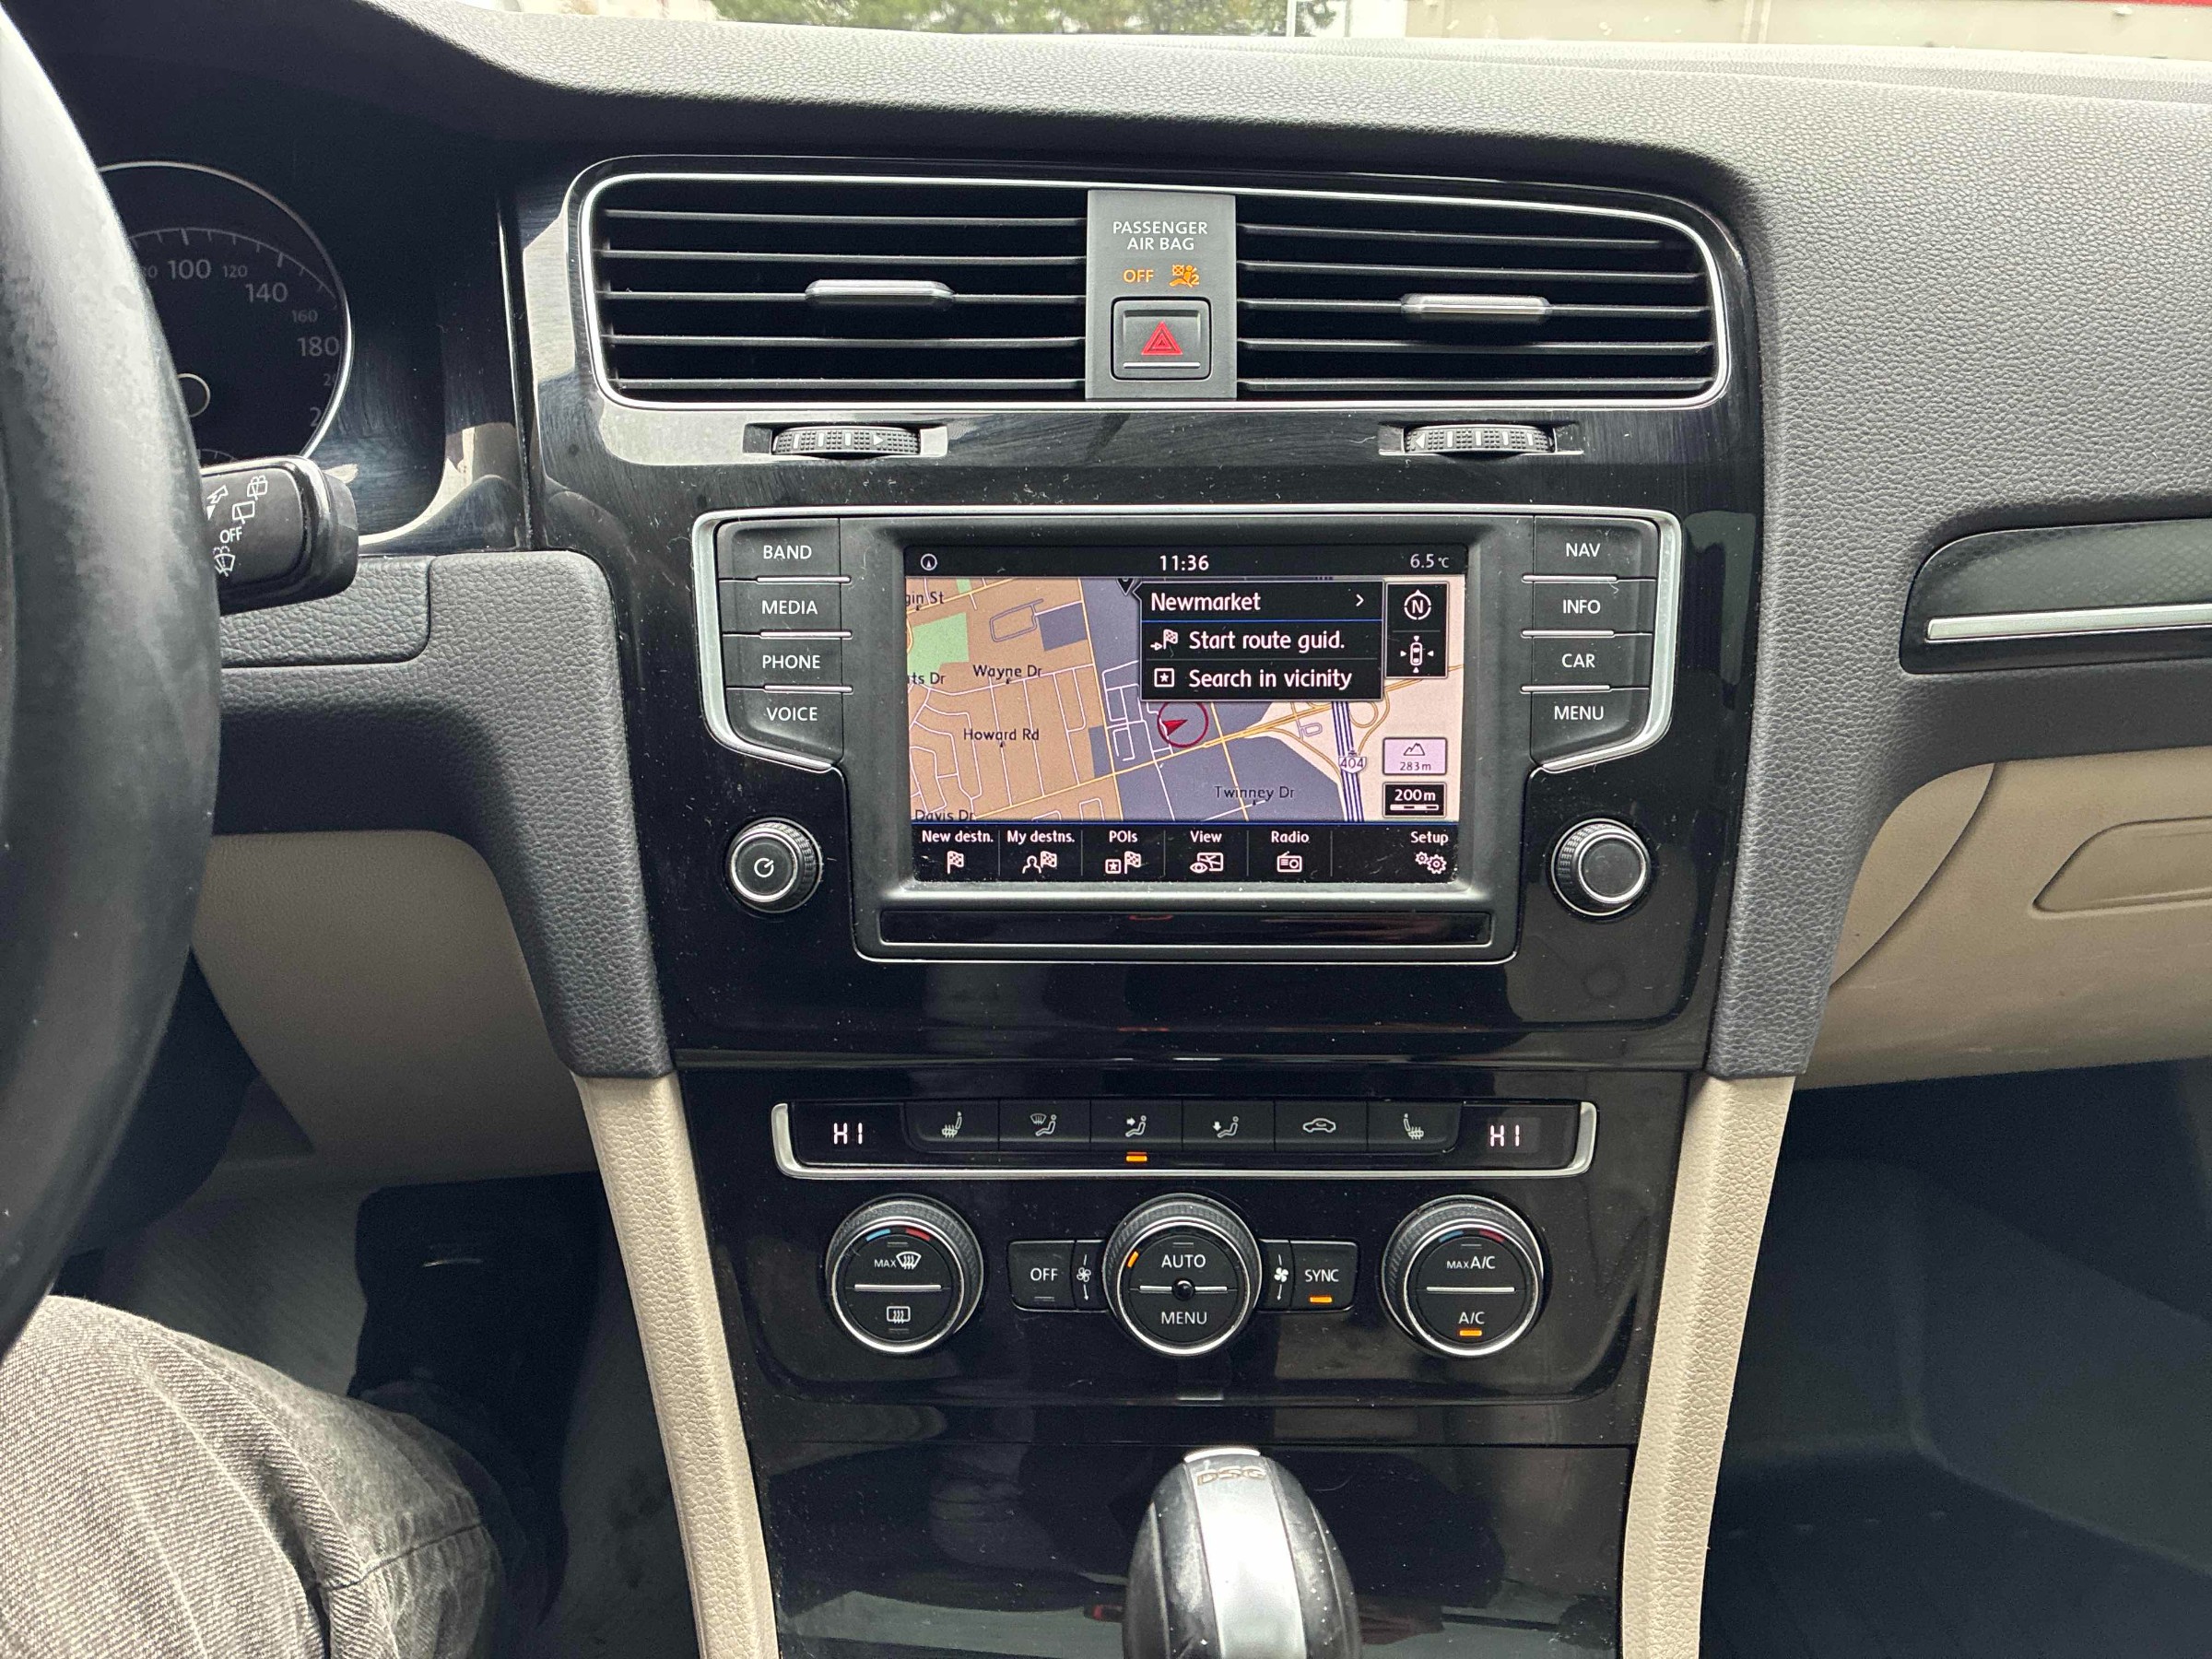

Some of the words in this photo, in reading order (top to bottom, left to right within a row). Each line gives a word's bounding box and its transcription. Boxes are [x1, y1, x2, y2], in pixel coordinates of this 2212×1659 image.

[1112, 221, 1208, 235] PASSENGER
[1126, 237, 1155, 251] AIR
[1159, 237, 1194, 251] BAG
[167, 259, 212, 279] 100
[221, 265, 248, 278] 120
[1124, 269, 1154, 283] OFF
[245, 282, 289, 303] 140
[291, 310, 318, 324] 160
[298, 336, 340, 358] 180
[219, 526, 243, 544] OFF
[763, 545, 812, 559] BAND
[1566, 543, 1601, 558] NAV
[1159, 555, 1209, 571] 11:36
[930, 591, 945, 605] St
[1151, 593, 1261, 611] Newmarket
[761, 600, 818, 615] MEDIA
[1562, 599, 1601, 614] INFO
[1189, 631, 1236, 650] Start
[1242, 632, 1291, 650] route
[1298, 631, 1346, 653] guid.
[762, 654, 820, 669] PHONE
[1561, 653, 1595, 668] CAR
[930, 672, 946, 685] Dr
[972, 665, 1022, 681] Wayne
[1028, 665, 1042, 677] Dr
[1189, 669, 1253, 688] Search
[1259, 669, 1277, 687] in
[1283, 669, 1352, 690] vicinity
[766, 706, 818, 722] VOICE
[1554, 705, 1605, 721] MENU
[963, 728, 1017, 741] Howard
[1023, 728, 1040, 741] Rd
[1340, 757, 1364, 769] 404
[1215, 785, 1274, 801] Twinney
[1280, 784, 1295, 798] Dr
[915, 809, 954, 821] Davis
[959, 809, 974, 821] Dr
[922, 830, 952, 842] New
[955, 830, 994, 842] destn.
[1006, 830, 1027, 845] My
[1030, 830, 1076, 843] destns.
[1109, 830, 1138, 842] POIs
[1190, 830, 1222, 843] View
[1271, 830, 1310, 843] Radio
[1410, 831, 1449, 846] Setup
[874, 1259, 897, 1269] MAX
[1161, 1253, 1206, 1269] AUTO
[1446, 1260, 1469, 1269] MAX
[1470, 1255, 1496, 1269] A/C
[1030, 1267, 1059, 1282] OFF
[1304, 1268, 1340, 1284] SYNC
[1160, 1310, 1208, 1325] MENU
[1458, 1311, 1486, 1324] A/C
[1196, 1466, 1267, 1487] DSG
